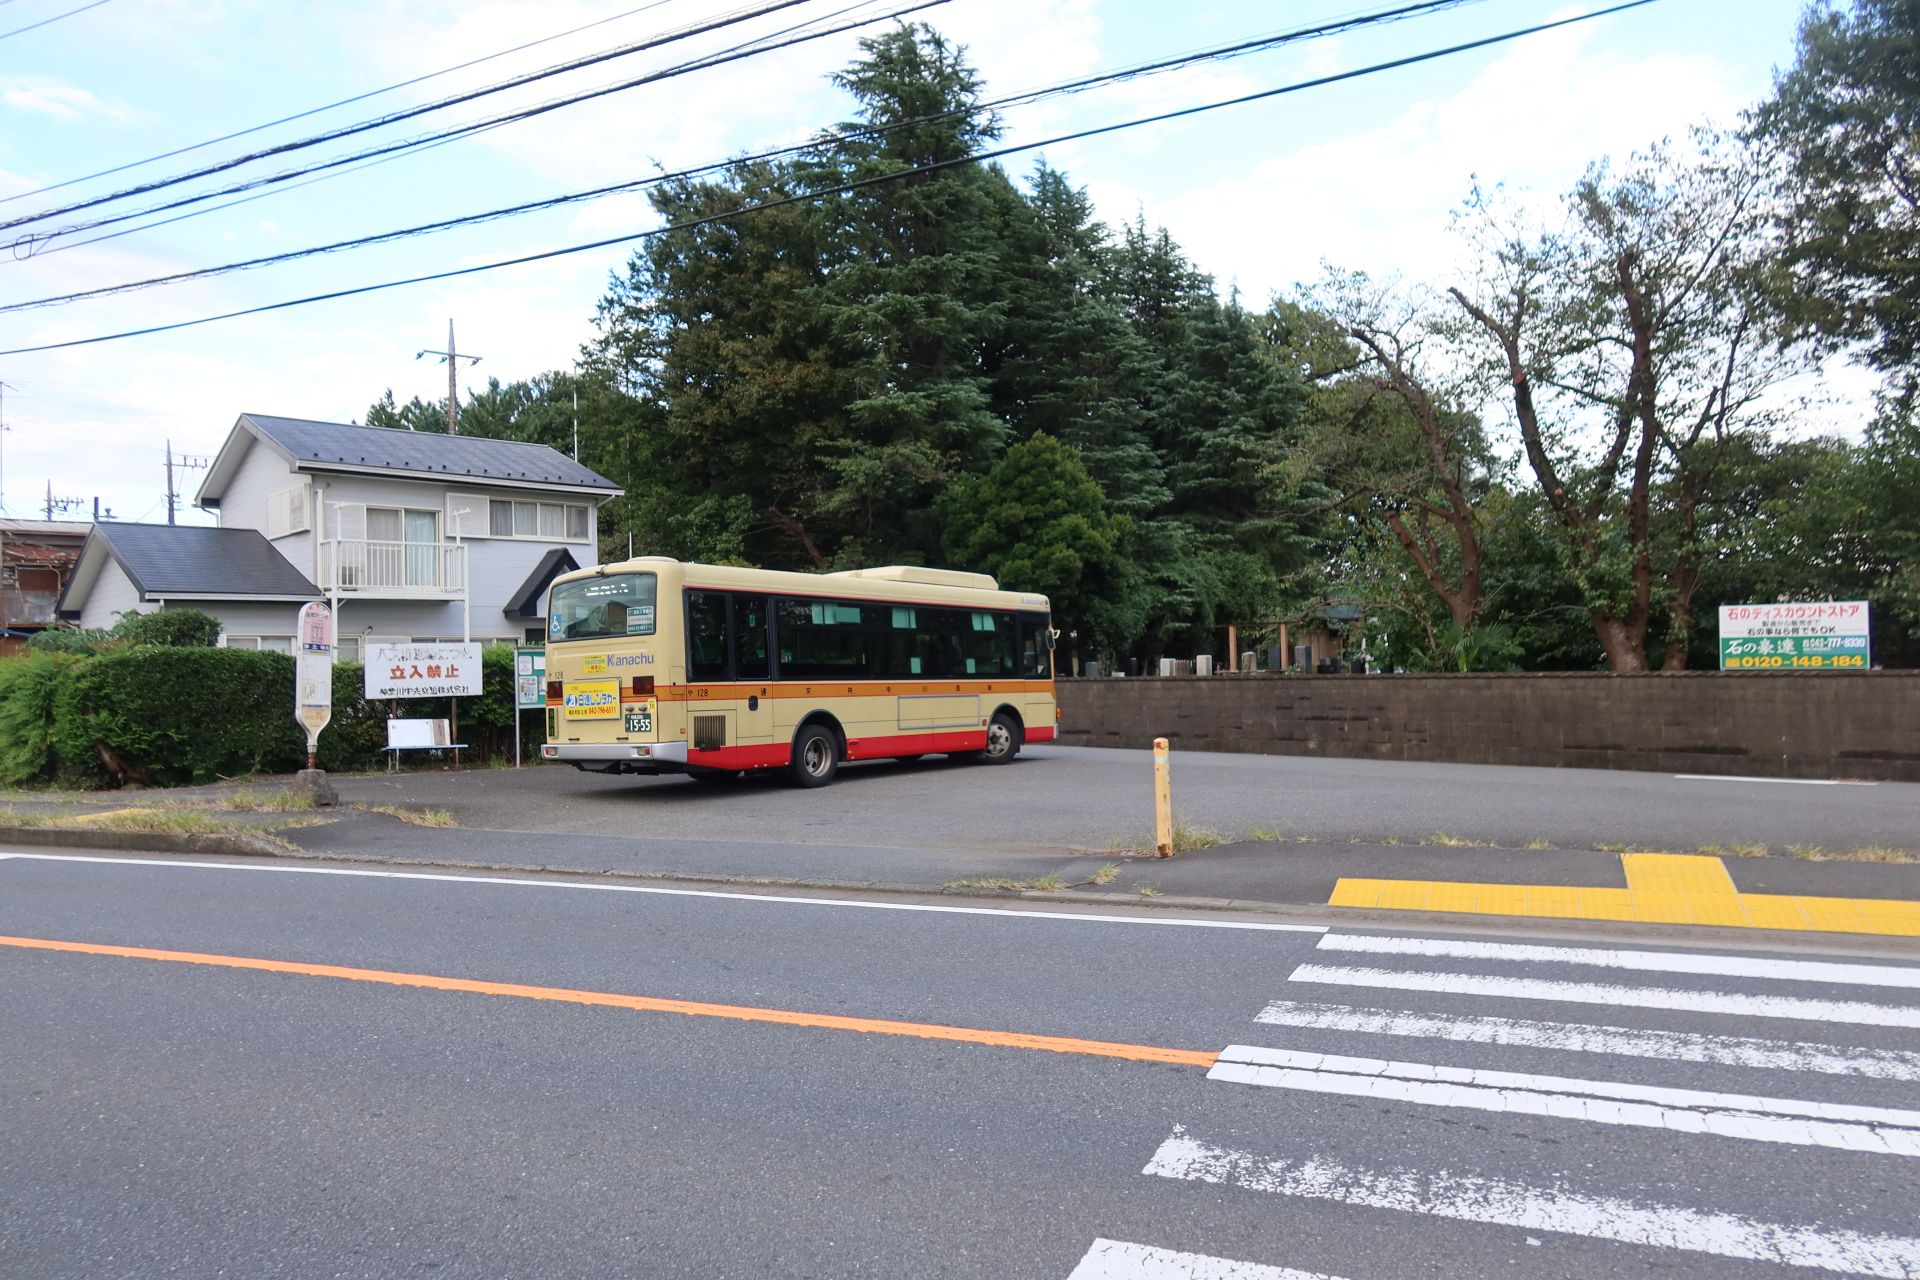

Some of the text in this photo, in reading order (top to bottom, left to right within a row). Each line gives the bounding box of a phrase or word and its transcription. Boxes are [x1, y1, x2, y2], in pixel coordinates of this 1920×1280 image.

[1727, 605, 1860, 620] 石のディスカウントストア
[607, 652, 654, 666] Kanachu
[1742, 655, 1864, 667] 0120-148-184
[390, 663, 460, 680] 立入禁止
[697, 688, 709, 697] 128
[629, 719, 651, 731] 15-55
